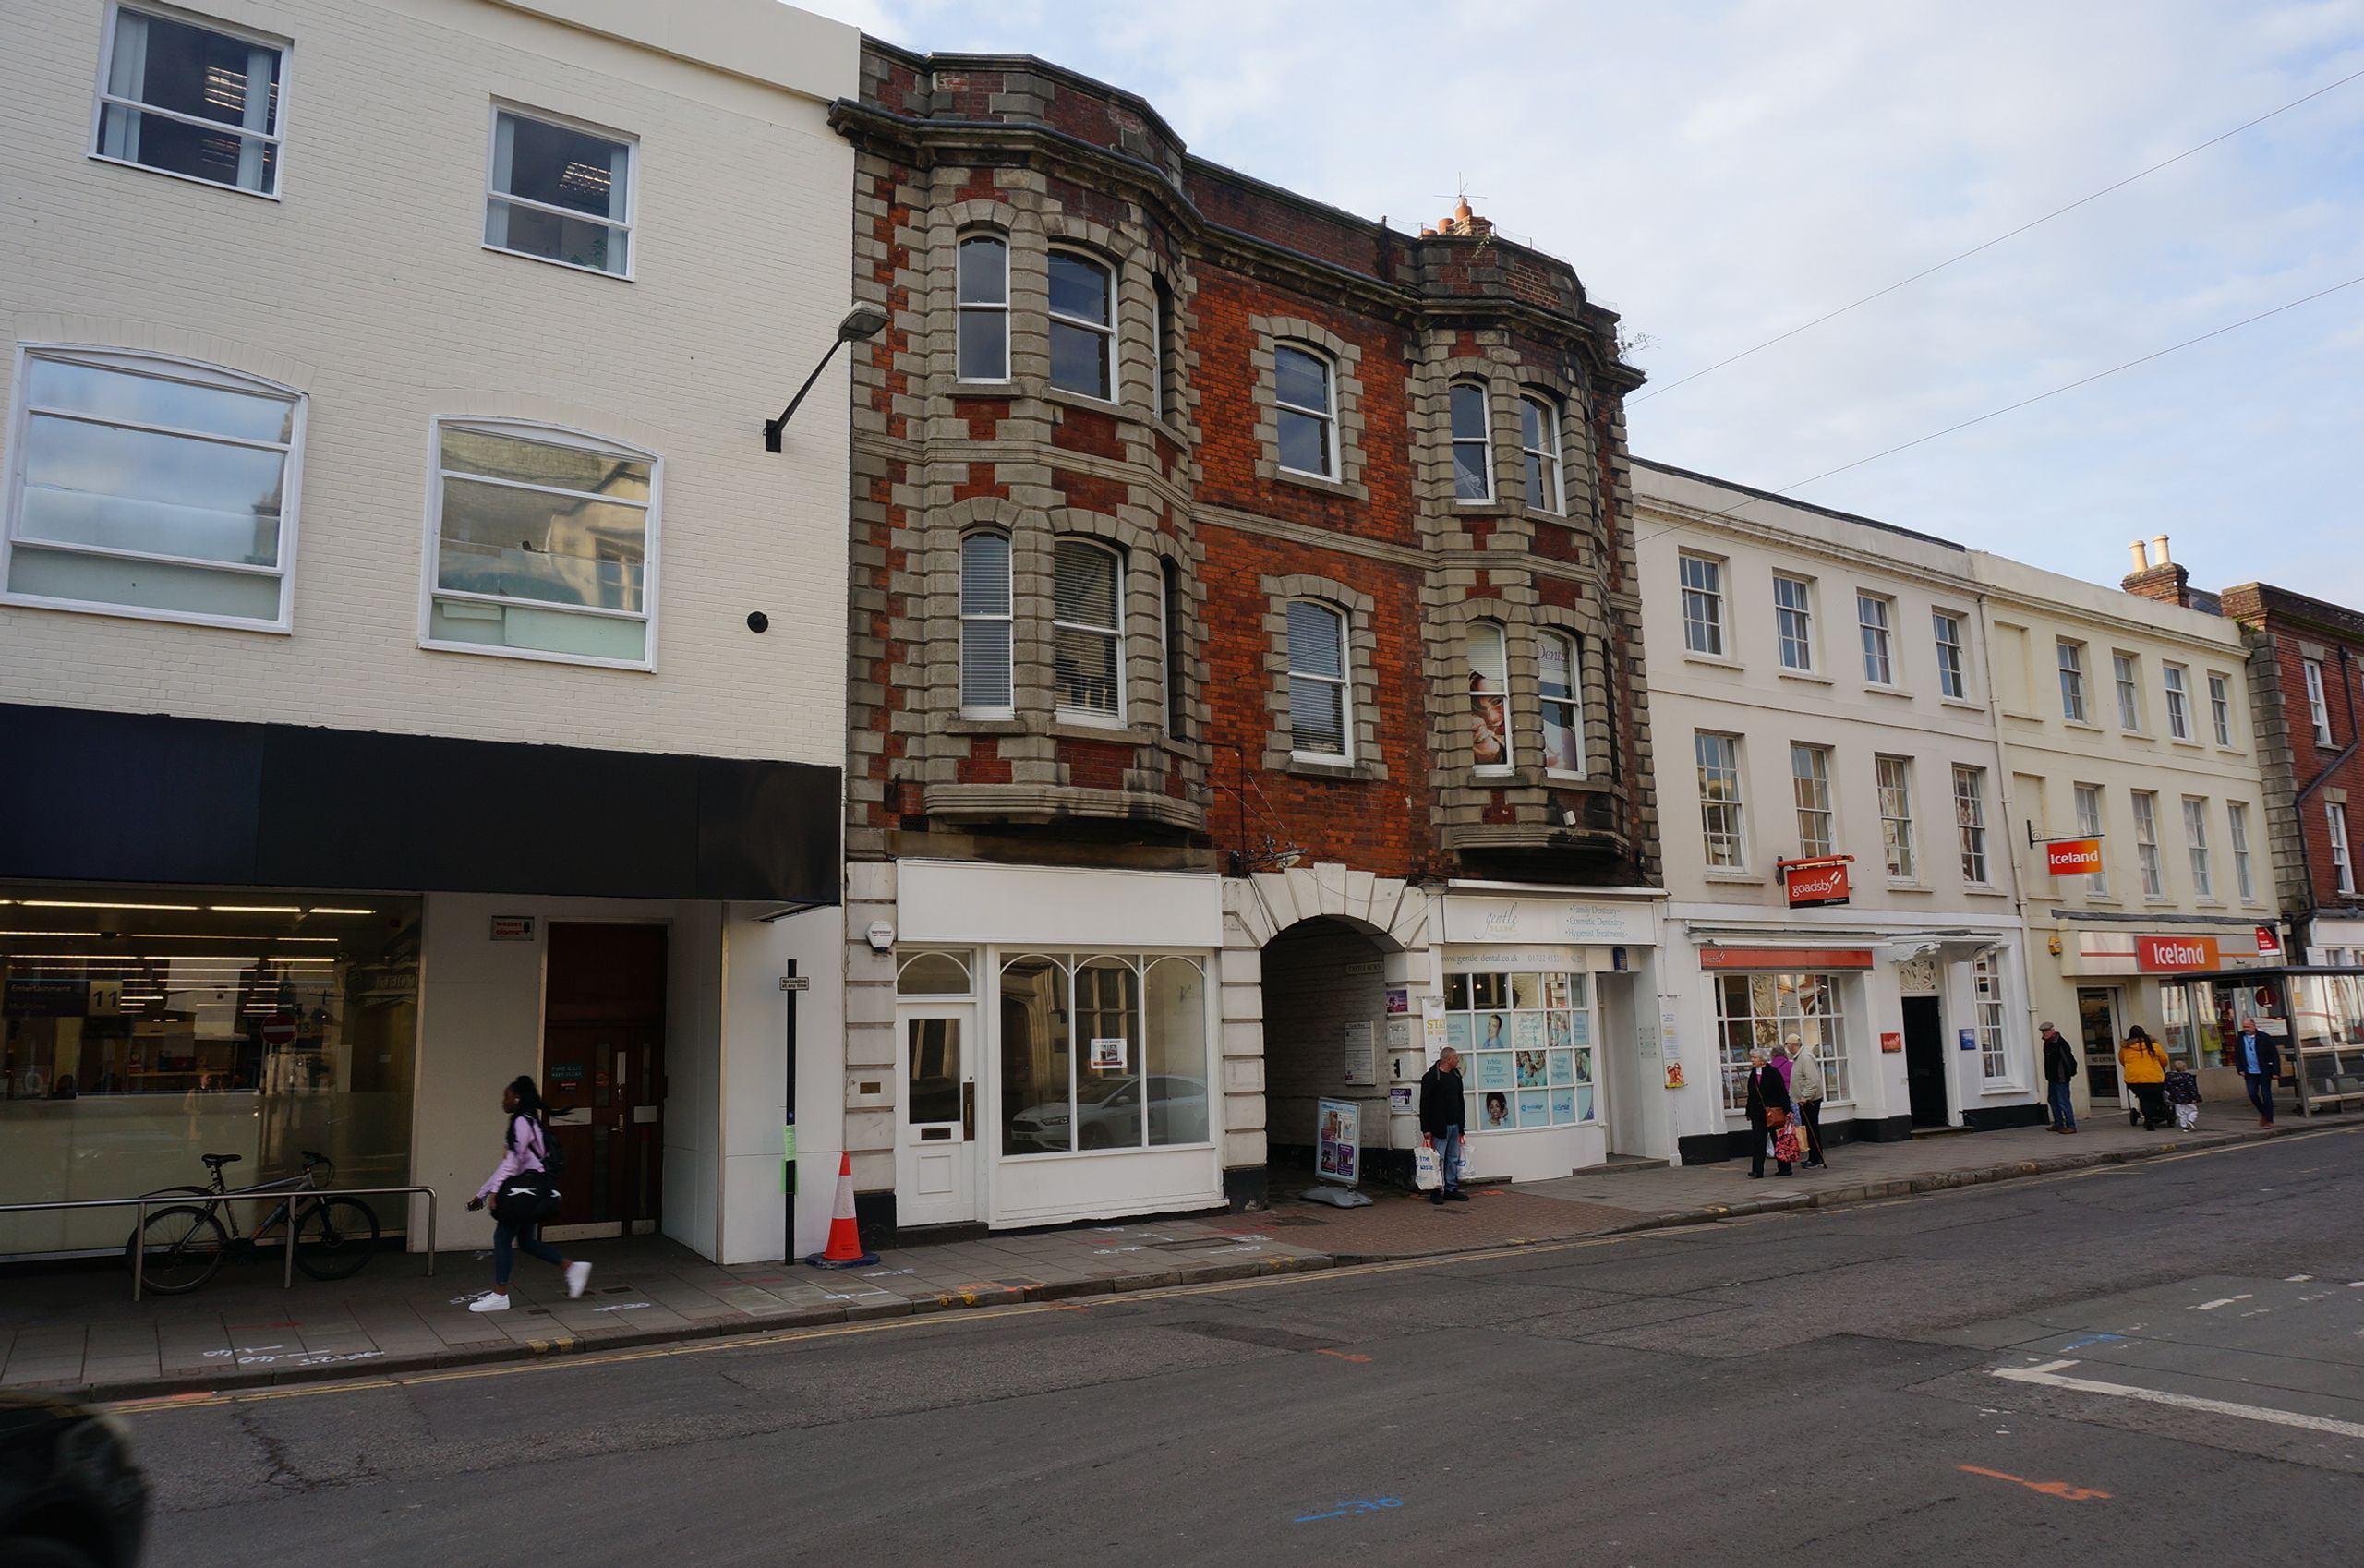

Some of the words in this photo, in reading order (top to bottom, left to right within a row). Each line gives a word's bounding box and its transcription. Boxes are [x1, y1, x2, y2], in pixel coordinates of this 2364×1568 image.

[2050, 850, 2098, 865] Iceland
[1791, 879, 1833, 897] goadsby
[1573, 905, 1590, 916] Family
[1592, 906, 1617, 917] Dentistry
[1474, 901, 1518, 939] gentle
[1569, 917, 1596, 925] Cosmetic
[1597, 918, 1623, 929] Dentistry
[2153, 942, 2205, 965] Iceland
[92, 990, 118, 1007] 11
